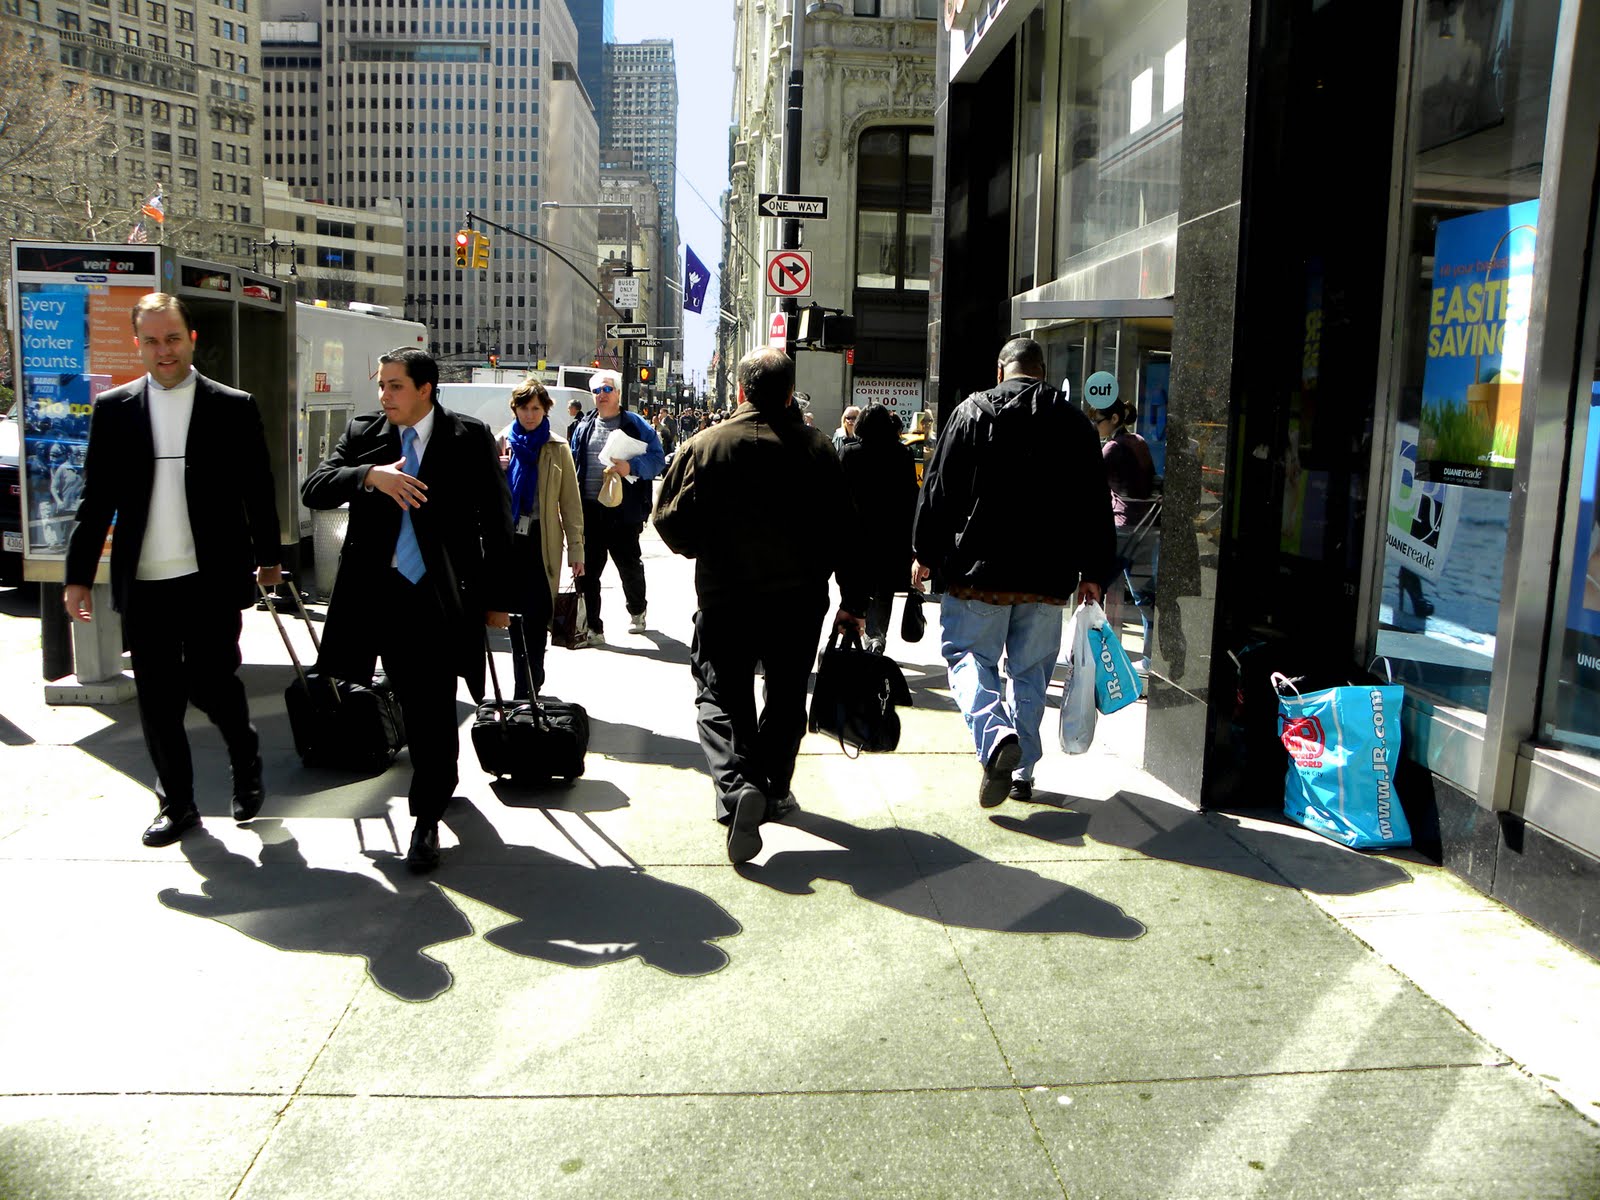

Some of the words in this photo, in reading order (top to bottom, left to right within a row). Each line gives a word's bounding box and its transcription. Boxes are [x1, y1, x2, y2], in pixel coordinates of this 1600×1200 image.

[769, 201, 788, 211] ONE
[798, 203, 819, 212] WAY
[82, 259, 135, 272] verizon
[21, 296, 66, 316] Every
[1430, 279, 1513, 326] EASTE
[22, 315, 59, 330] New
[22, 334, 74, 349] Yorker
[22, 355, 82, 369] counts.
[857, 380, 917, 388] MAGNIFICENT
[1089, 383, 1112, 396] out
[1296, 760, 1323, 768] WORLD
[1370, 689, 1394, 840] www.JR.com
